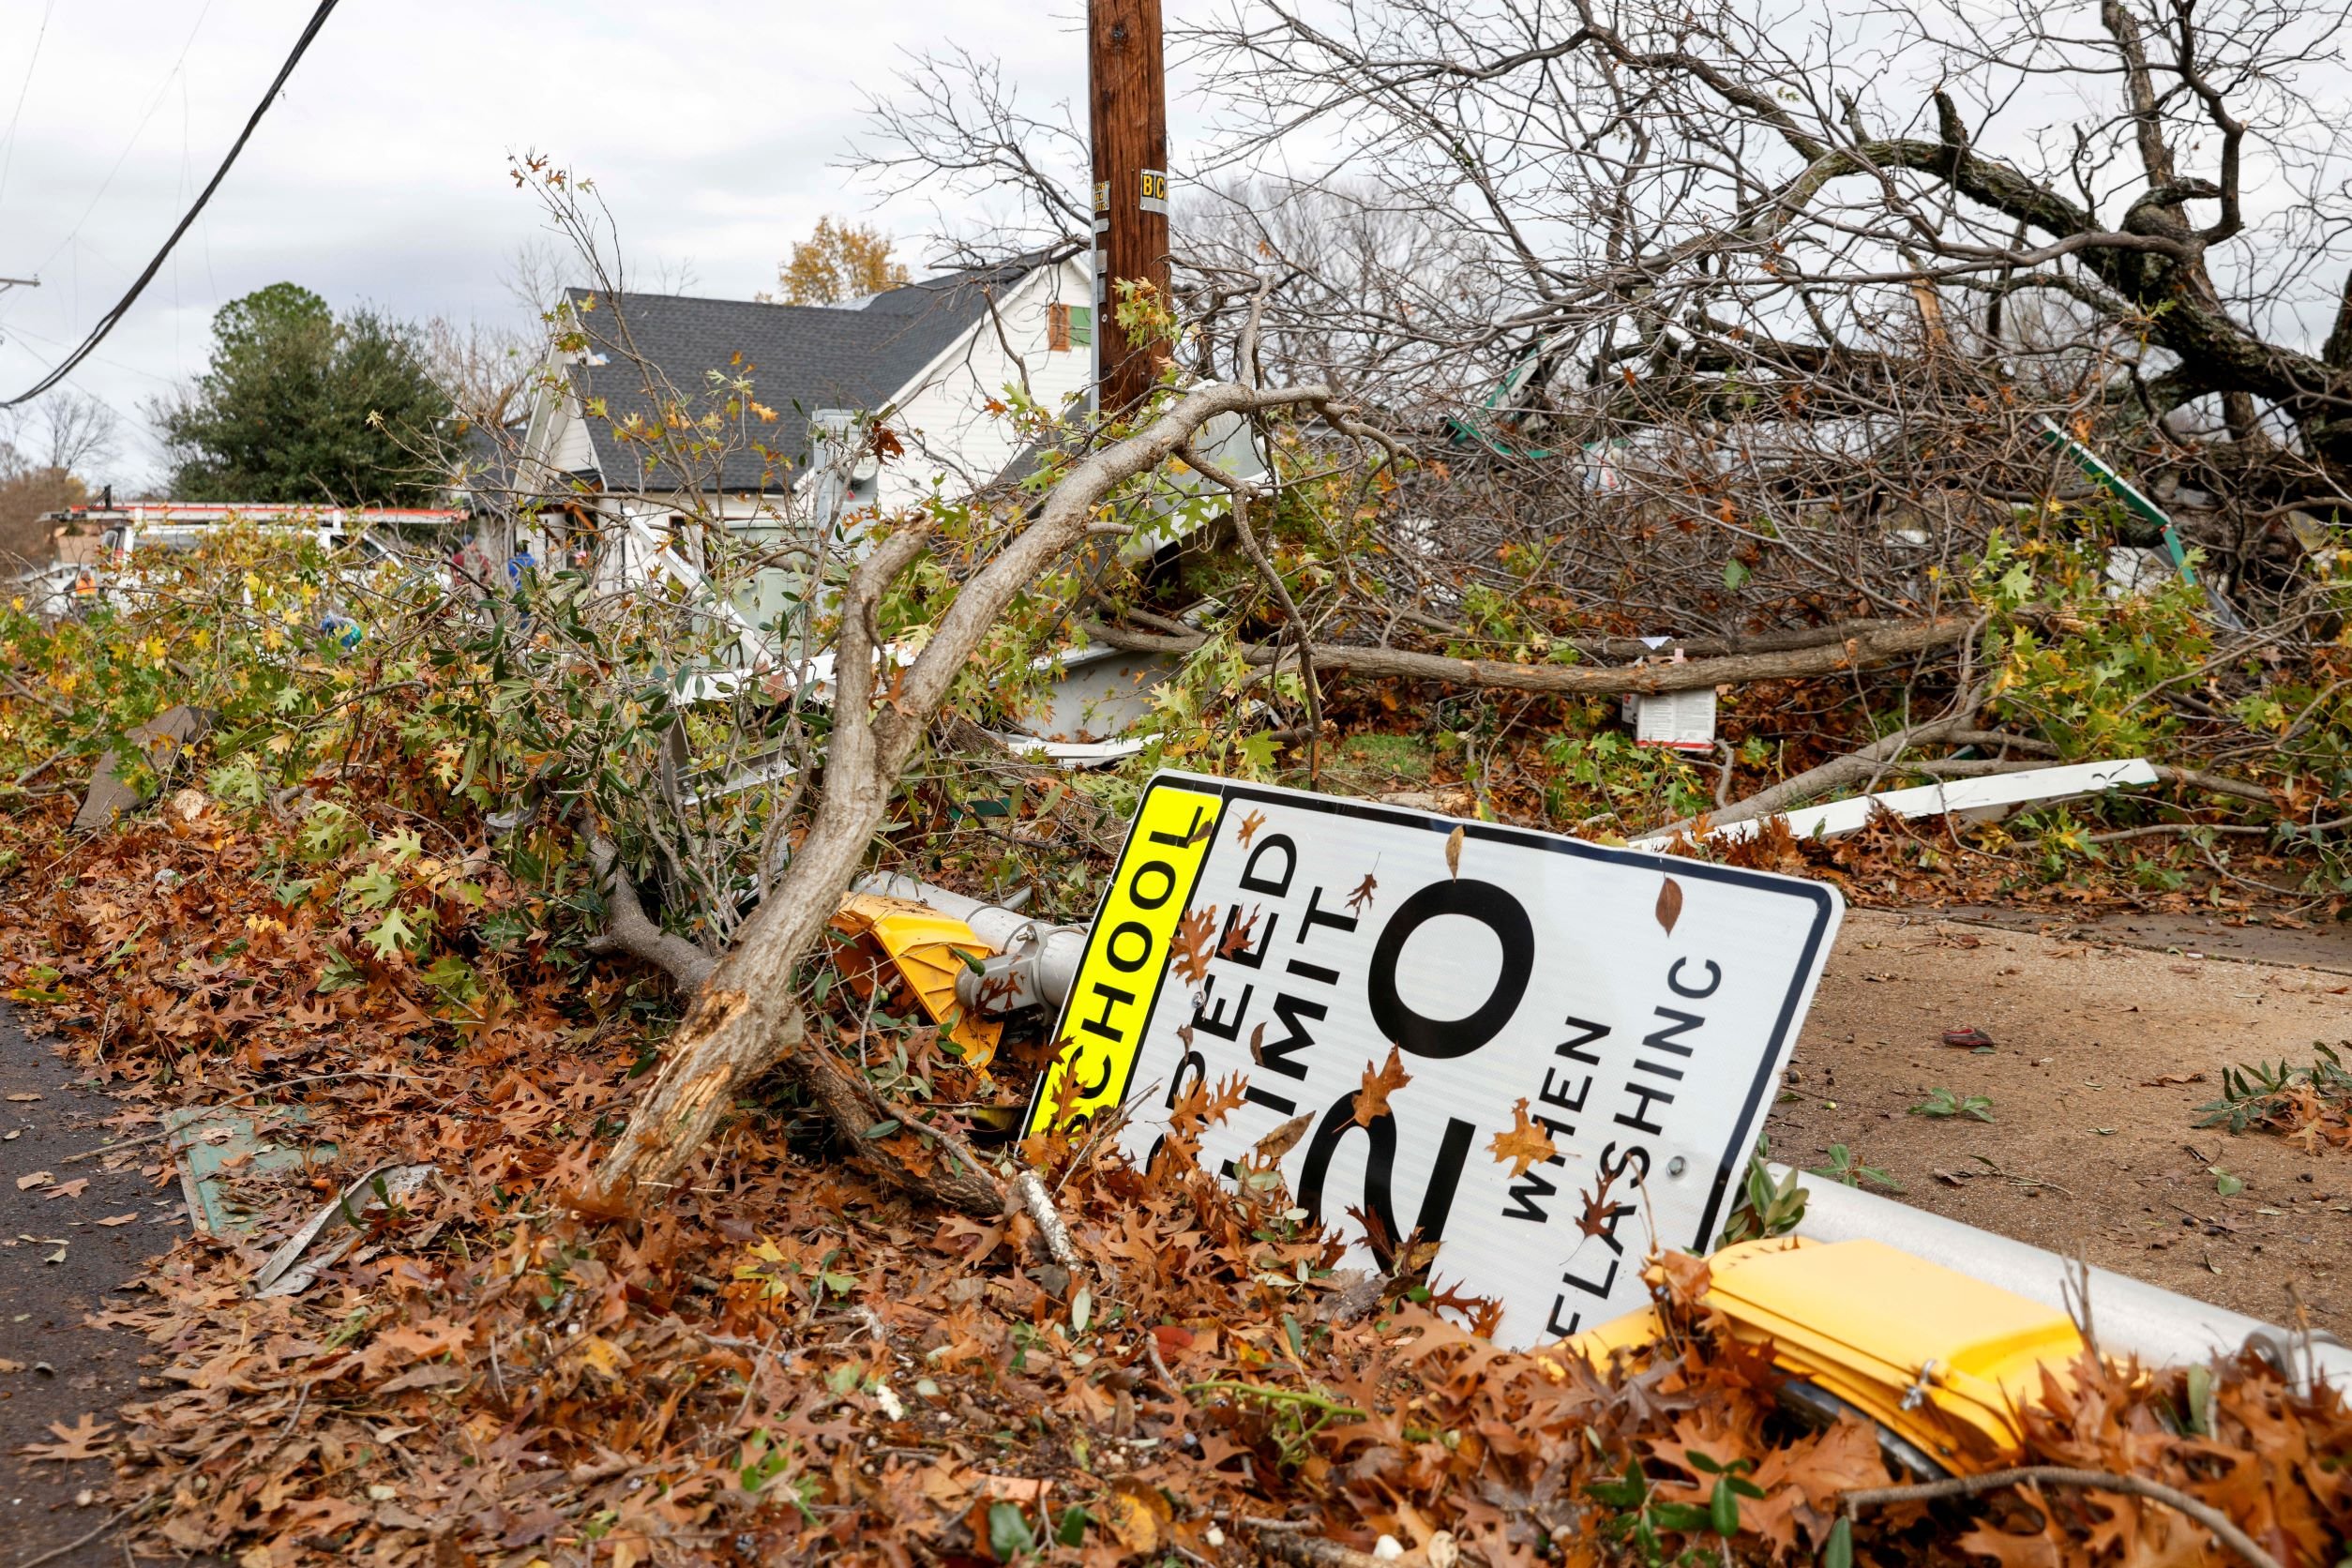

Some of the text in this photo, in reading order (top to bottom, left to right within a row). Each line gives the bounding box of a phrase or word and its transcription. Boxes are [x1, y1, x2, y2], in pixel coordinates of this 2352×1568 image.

[1143, 174, 1167, 200] BC
[1221, 886, 1358, 1179] IMIT
[1297, 879, 1535, 1283] 20
[1501, 1016, 1611, 1223] WHEN
